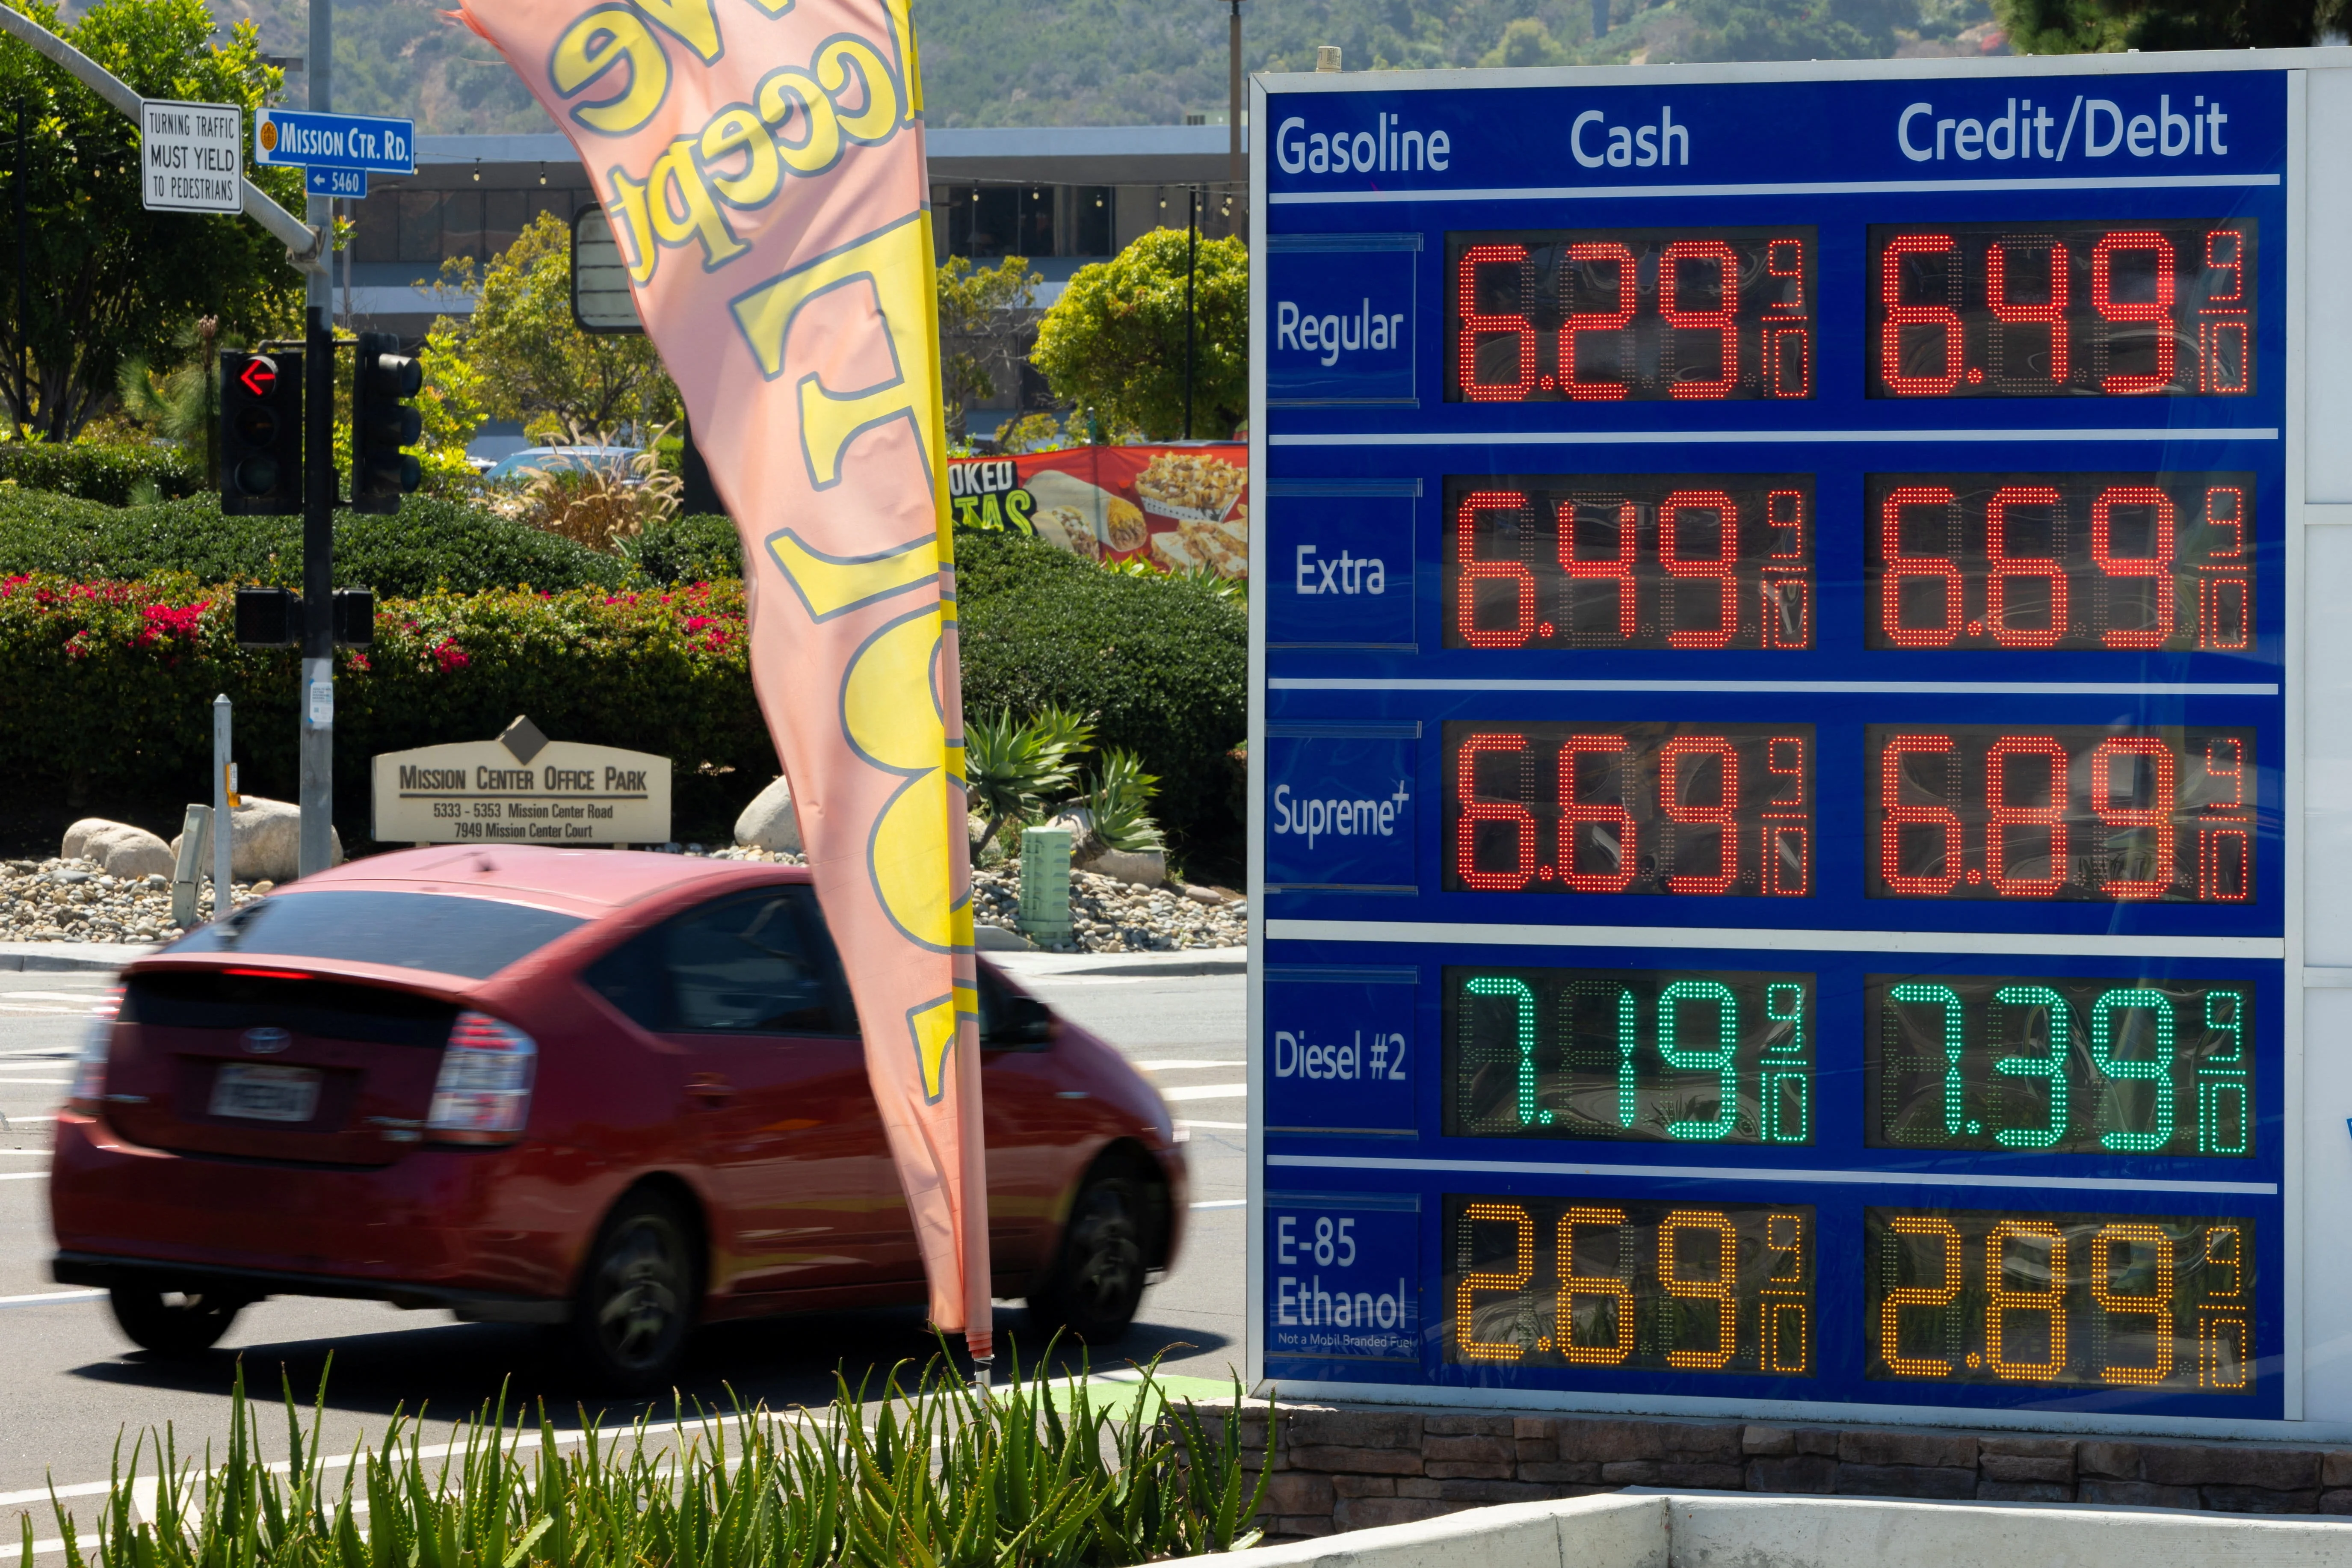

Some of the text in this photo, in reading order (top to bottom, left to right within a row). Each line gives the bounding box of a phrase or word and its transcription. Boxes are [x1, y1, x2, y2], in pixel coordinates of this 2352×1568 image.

[150, 113, 234, 139] TURNING TRAFFIC
[1276, 112, 1450, 174] Gasoline
[1571, 106, 1689, 168] Cash
[1898, 95, 2228, 162] Credit/Debit
[151, 144, 234, 172] MUST YIELD
[154, 176, 233, 201] TO PEDESTRIANS
[332, 172, 359, 192] 5460
[1278, 298, 1403, 366] Regular
[1459, 240, 1737, 401] 6.29
[1882, 232, 2174, 394] 6.49
[948, 461, 1012, 496] OKED
[1296, 544, 1385, 595] Extra
[1459, 491, 1737, 648] 6.49
[1882, 487, 2174, 647] 6.69
[434, 803, 461, 818] 5333
[473, 803, 501, 818] 5353
[509, 804, 548, 819] Mission
[552, 804, 584, 819] Center
[588, 804, 613, 819] Road
[455, 823, 592, 838] 7949 Mission Center Court
[1274, 780, 1409, 849] Supreme+
[1458, 734, 1737, 893] 6.69
[1882, 735, 2174, 898] 6.89
[1275, 1031, 1406, 1080] Diesel #2
[1466, 977, 1737, 1139] 7.19
[1890, 984, 2173, 1151] 7.39
[1278, 1216, 1356, 1267] E-85
[1278, 1275, 1406, 1328] Ethanol
[1456, 1204, 1737, 1368] 2.69
[1882, 1216, 2173, 1383] 2.89
[1278, 1333, 1412, 1348] Not a Mobil Branded Fuel
